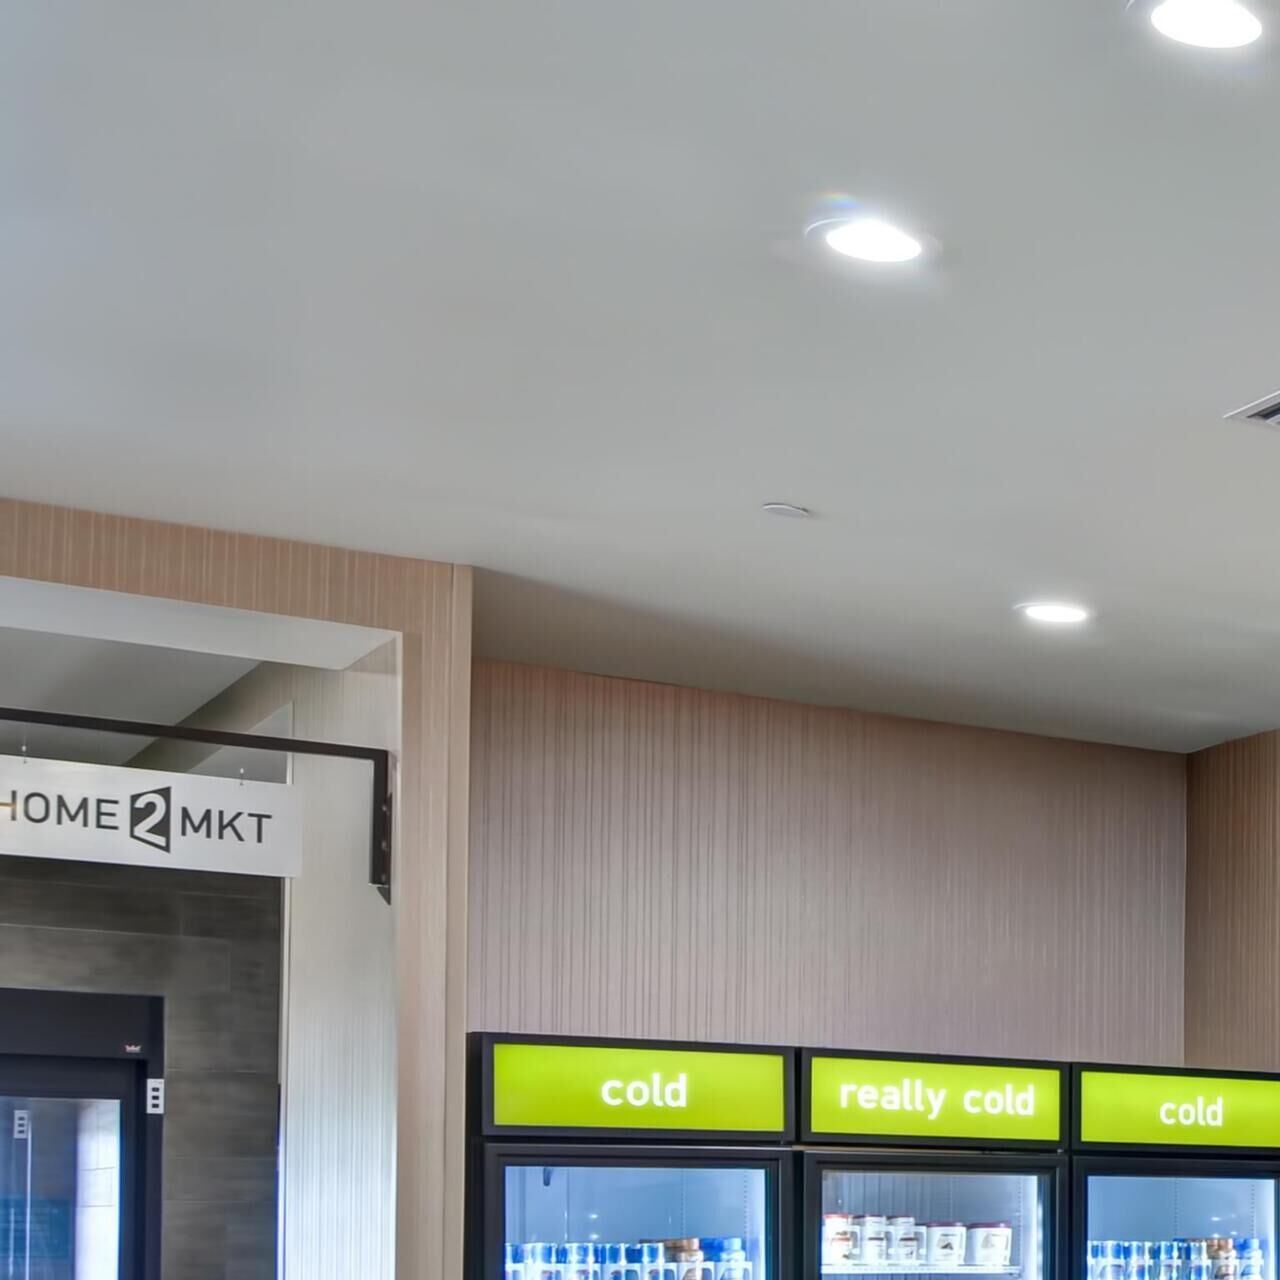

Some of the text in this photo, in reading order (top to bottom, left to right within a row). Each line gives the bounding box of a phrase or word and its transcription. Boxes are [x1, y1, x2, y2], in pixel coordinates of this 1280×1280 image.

[0, 789, 119, 830] HOME
[181, 807, 272, 843] MKT
[600, 1071, 688, 1108] cold
[839, 1078, 1035, 1120] really cold
[1159, 1095, 1223, 1127] cold
